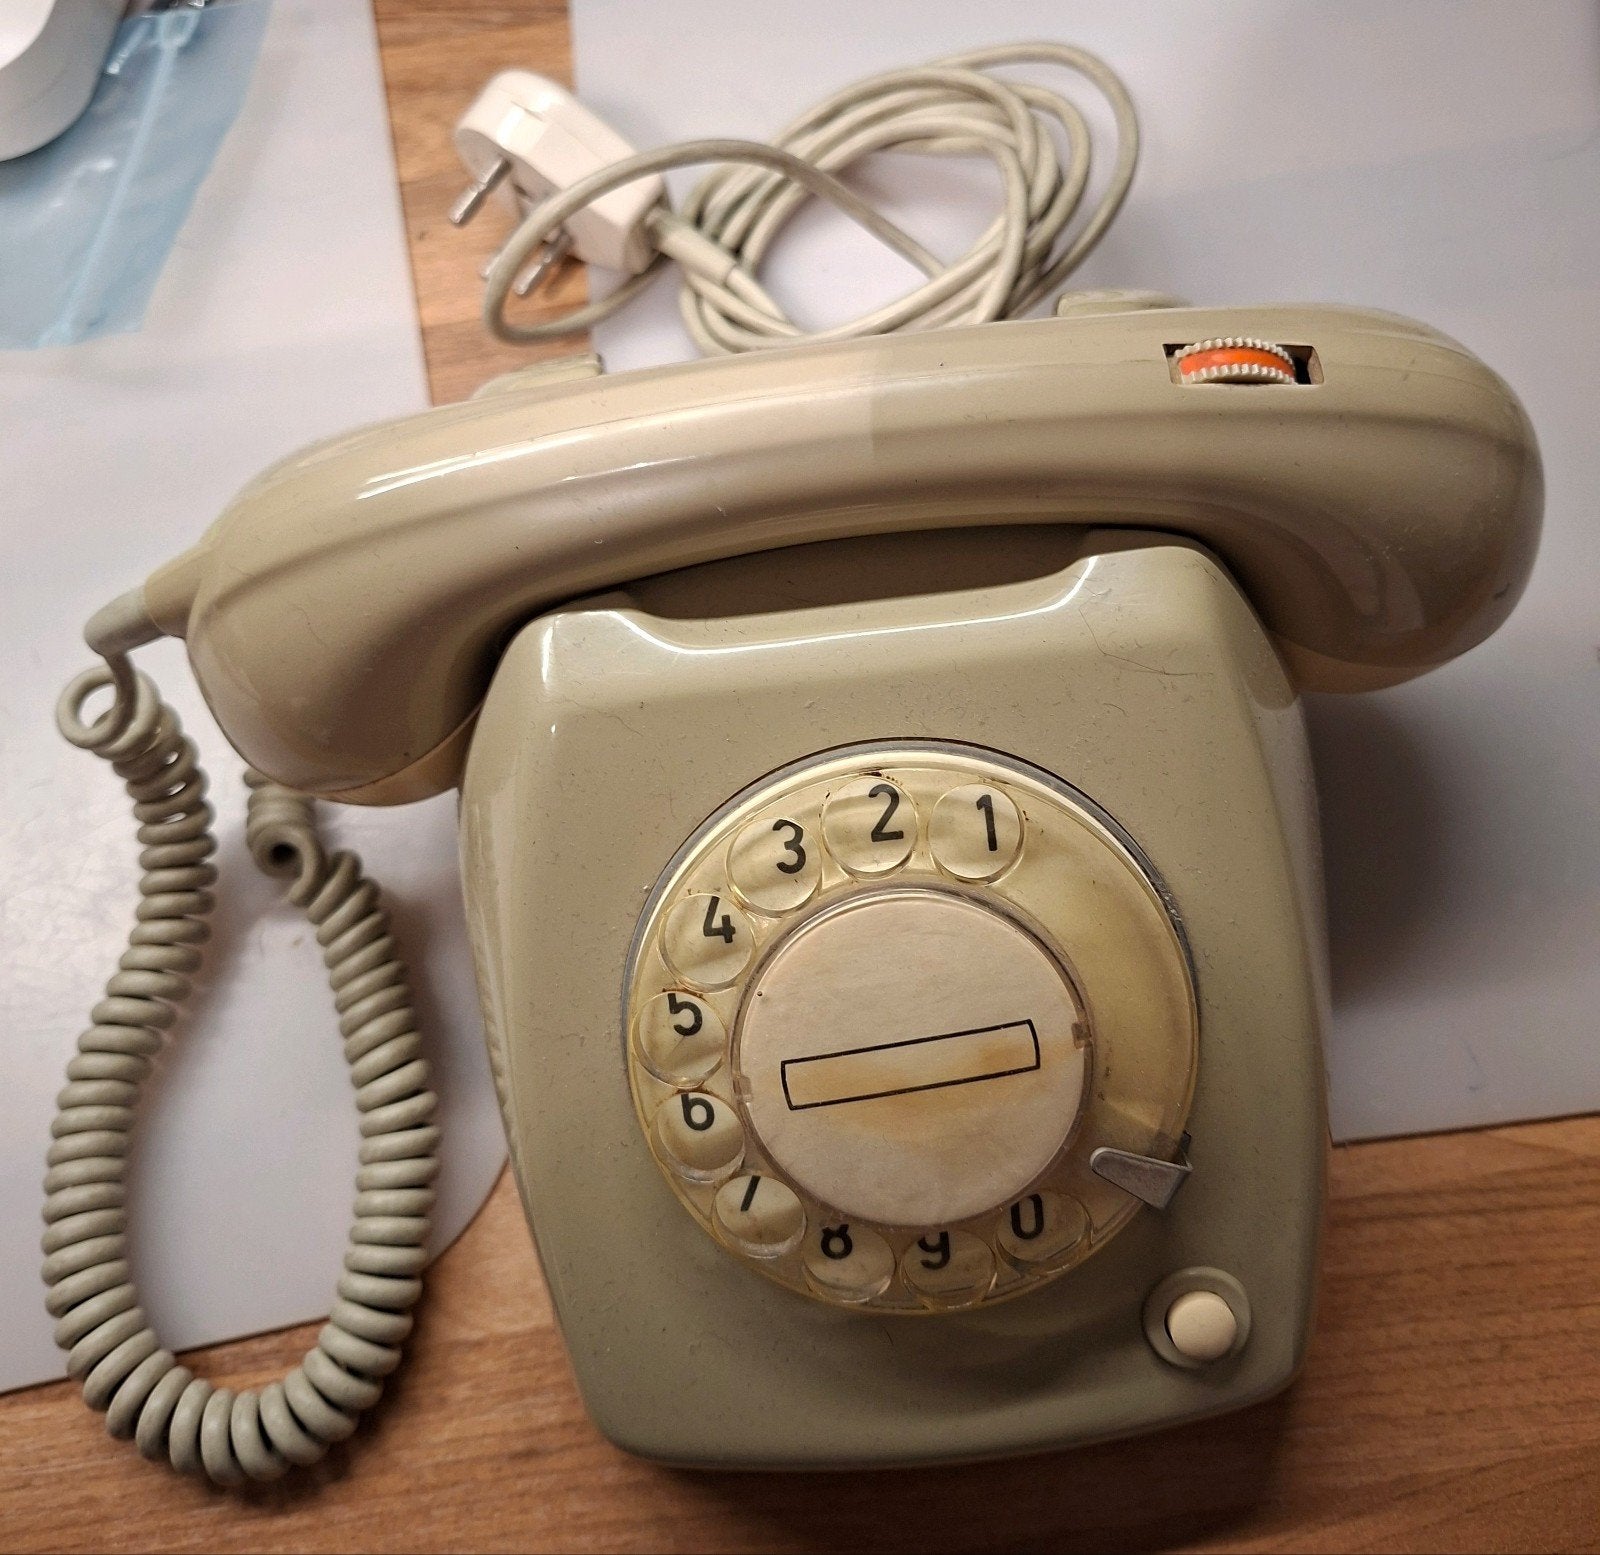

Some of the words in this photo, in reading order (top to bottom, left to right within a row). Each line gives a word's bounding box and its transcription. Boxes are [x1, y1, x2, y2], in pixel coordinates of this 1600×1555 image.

[868, 784, 904, 842] 2
[976, 794, 998, 852] 1
[772, 819, 806, 874] 3
[703, 896, 736, 943] 4
[667, 993, 702, 1036] 5
[681, 1094, 714, 1131] 6
[918, 1231, 950, 1270] 9
